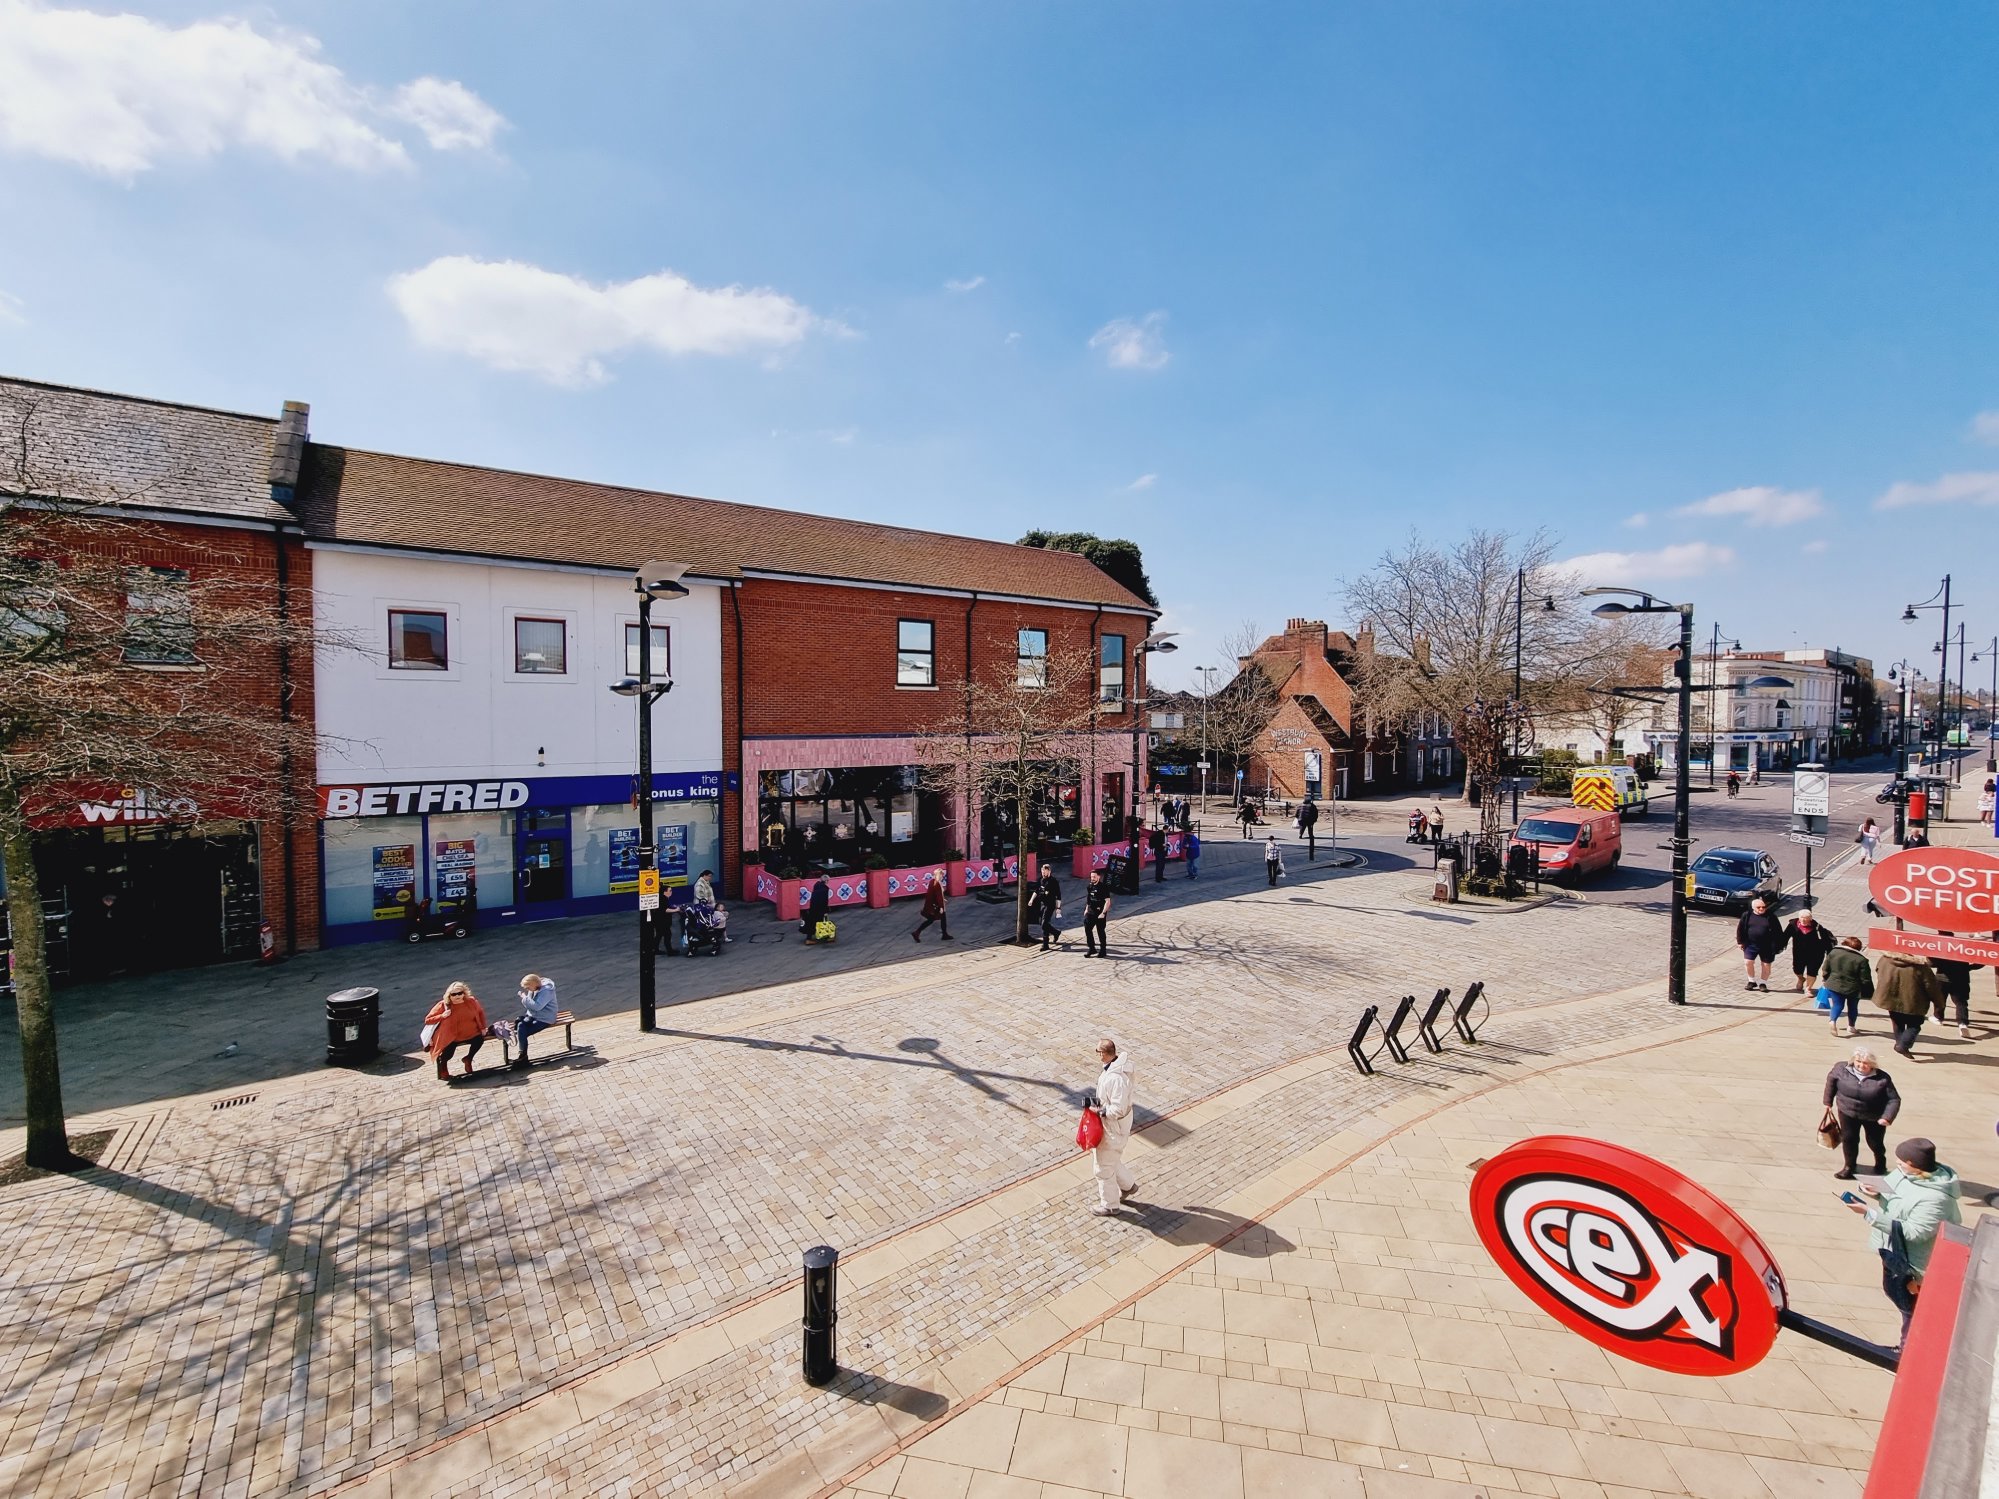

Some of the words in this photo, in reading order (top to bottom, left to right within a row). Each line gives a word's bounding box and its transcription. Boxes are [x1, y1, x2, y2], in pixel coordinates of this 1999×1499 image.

[702, 775, 718, 784] the
[325, 781, 530, 818] BETFRED
[651, 789, 683, 798] onus
[690, 786, 718, 797] king
[79, 788, 198, 822] wilko
[1906, 863, 1999, 890] POST
[1892, 934, 1942, 952] Travel
